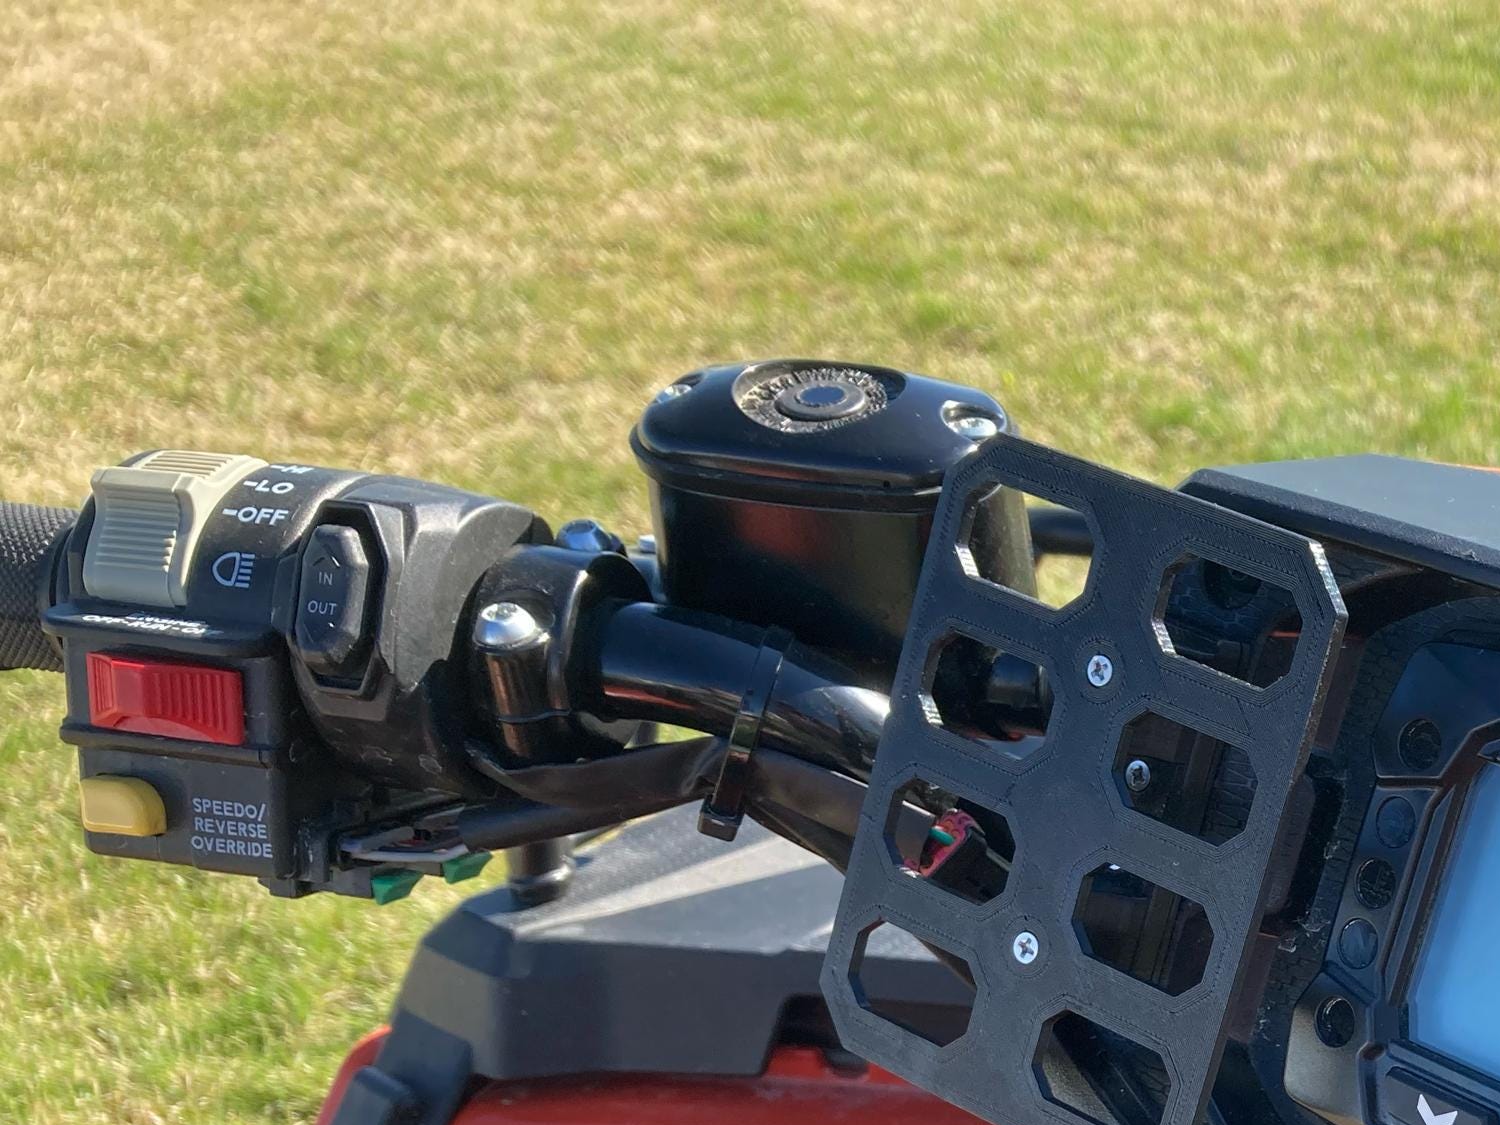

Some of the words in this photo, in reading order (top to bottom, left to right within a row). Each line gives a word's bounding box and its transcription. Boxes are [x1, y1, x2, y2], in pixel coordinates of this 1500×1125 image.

[237, 506, 289, 526] OFF
[319, 571, 333, 586] IN
[307, 600, 338, 615] OUT
[192, 798, 266, 821] SPEEDO/
[194, 816, 268, 839] REVERSE
[191, 835, 274, 859] OVERRIDE
